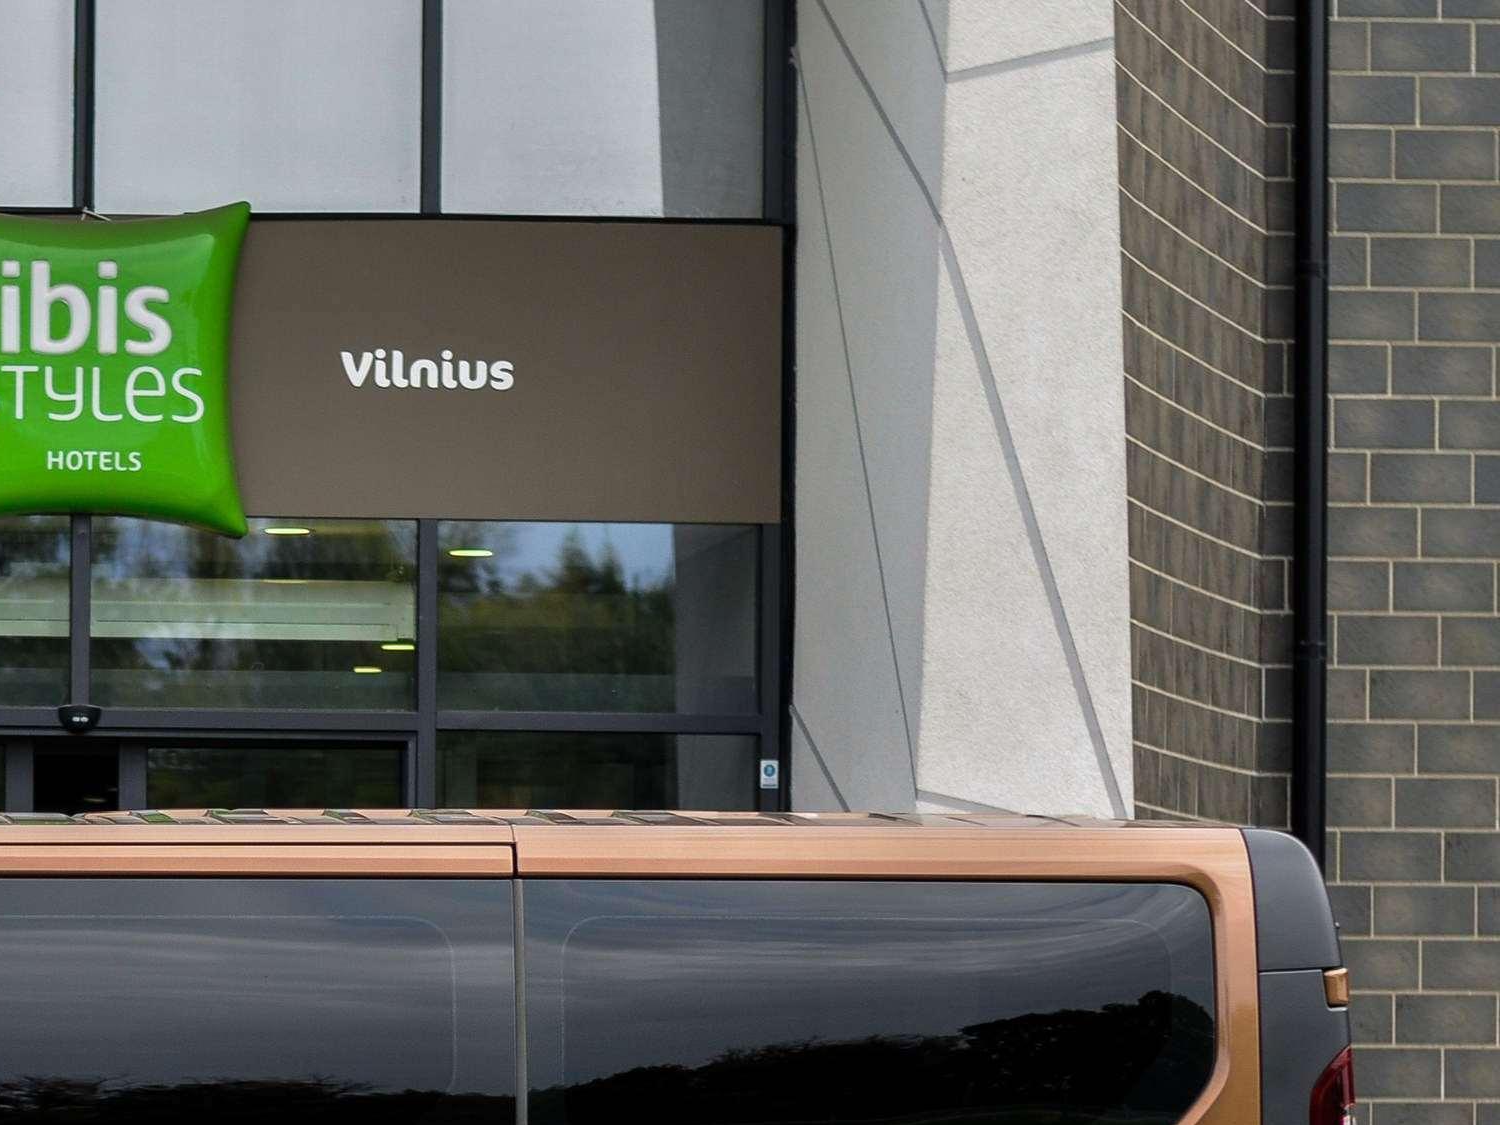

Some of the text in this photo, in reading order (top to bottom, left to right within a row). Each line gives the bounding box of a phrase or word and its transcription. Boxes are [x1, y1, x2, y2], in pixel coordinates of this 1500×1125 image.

[0, 259, 173, 356] ibis
[340, 348, 515, 391] Vilnius
[46, 450, 143, 472] HOTELS
